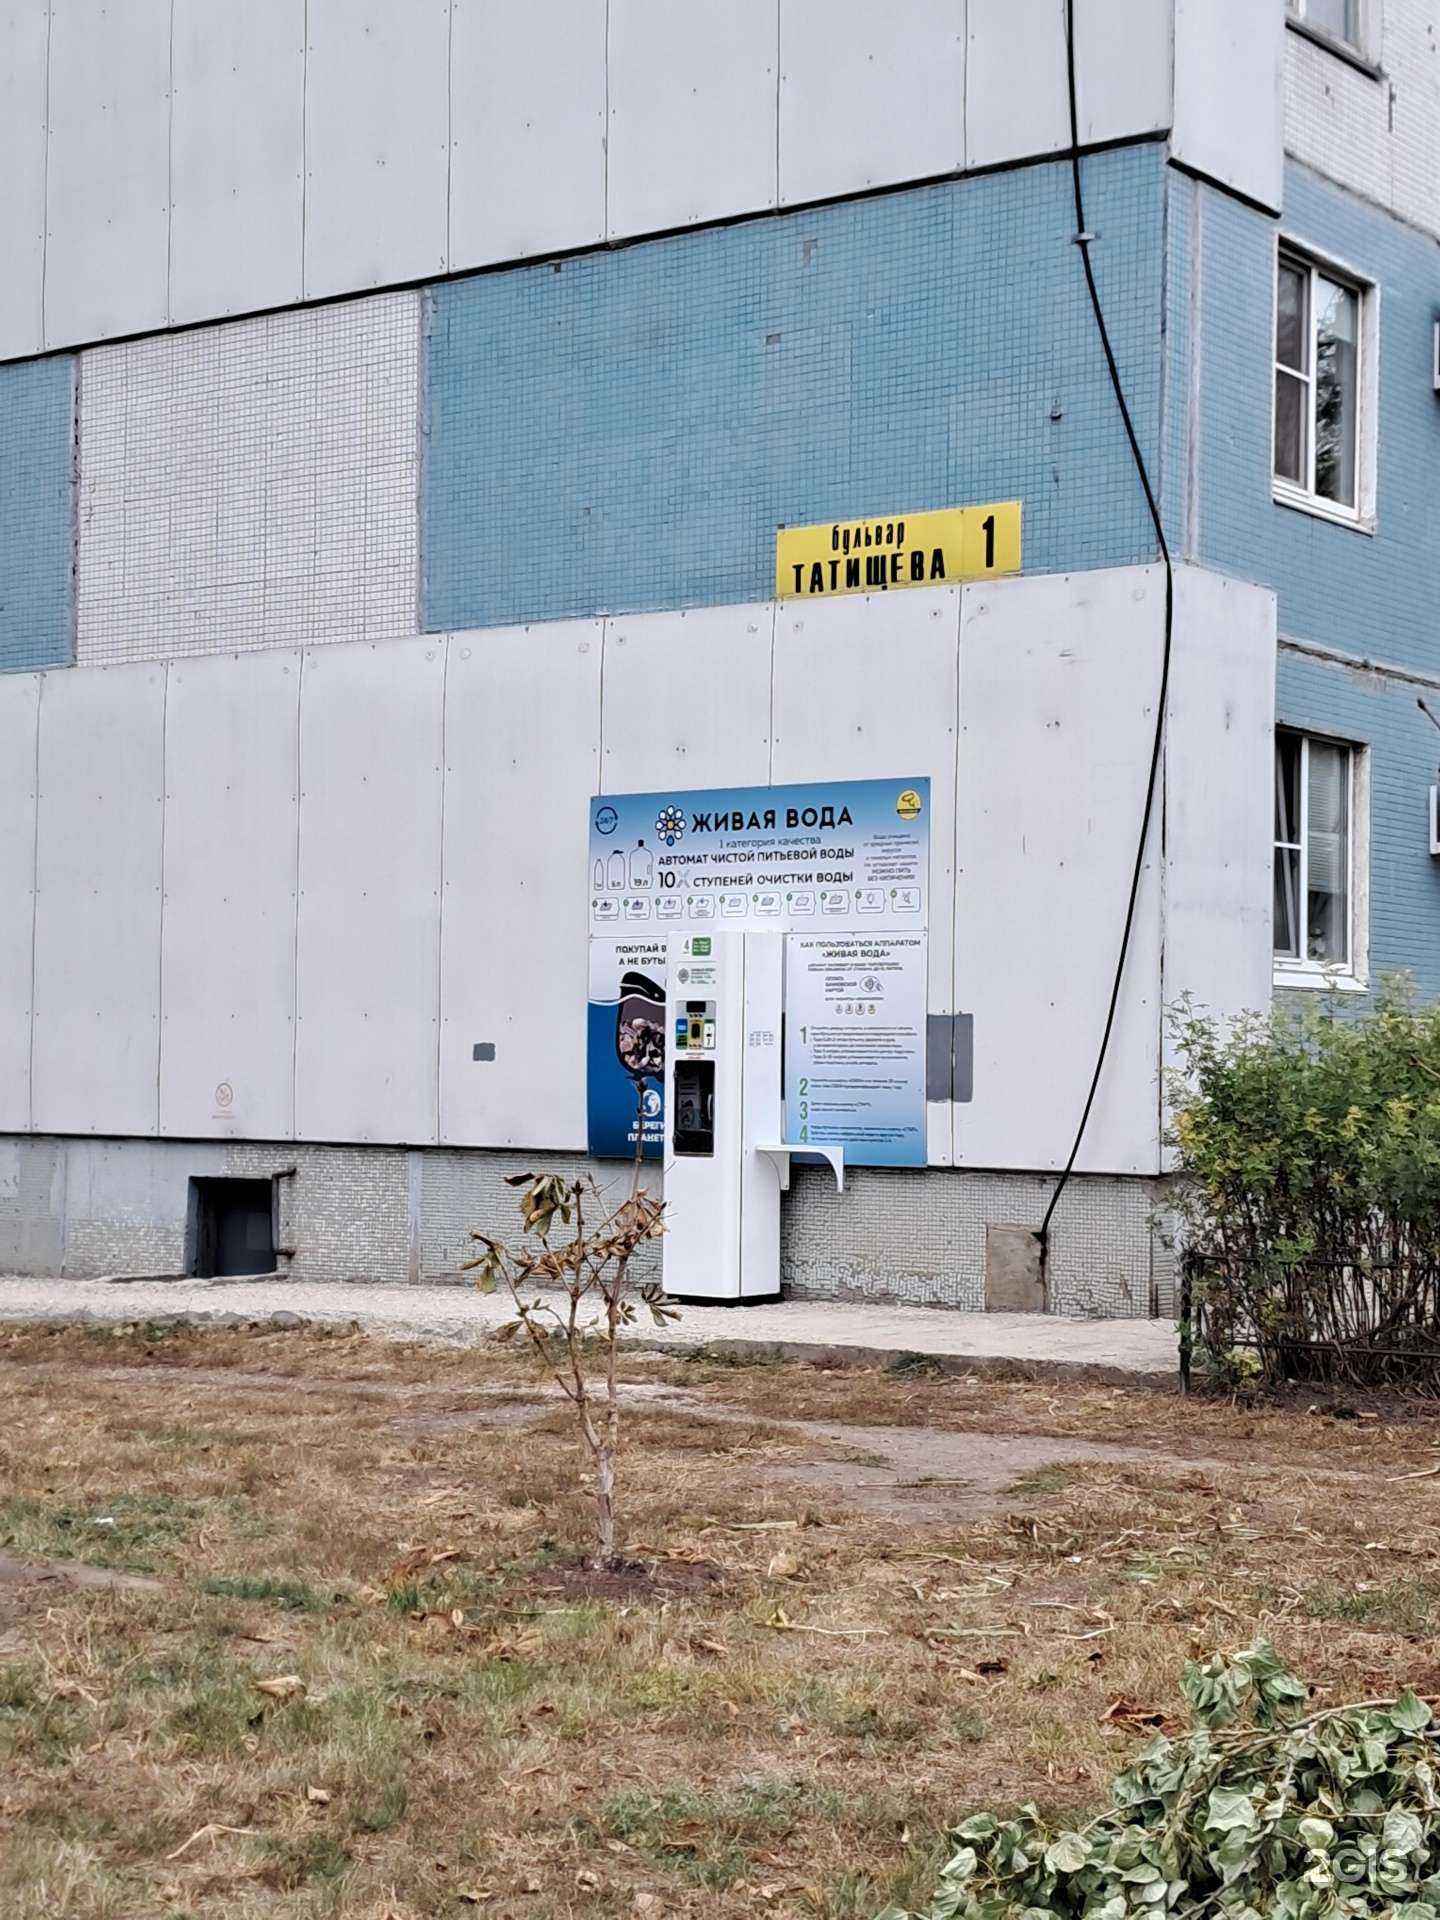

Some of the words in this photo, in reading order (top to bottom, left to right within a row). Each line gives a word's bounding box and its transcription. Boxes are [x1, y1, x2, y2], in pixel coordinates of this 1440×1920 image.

[832, 522, 905, 555] бульвар
[982, 515, 995, 568] 1
[792, 548, 946, 594] ТАТИЩЕВА
[691, 809, 776, 833] ЖИВАЯ
[786, 806, 853, 830] ВОДА
[726, 839, 776, 849] категория
[778, 836, 822, 846] качества
[658, 854, 708, 866] АВТОМАТ
[711, 851, 754, 864] ЧИСТОЙ
[757, 847, 817, 862] ПИТЬЕВОЙ
[820, 848, 855, 859] ВОДЫ
[693, 873, 753, 888] СТУПЕНЕЙ
[757, 873, 812, 885] ОЧИСТКИ
[816, 871, 853, 883] ВОДЫ
[615, 944, 659, 954] ПОКУПАЙ
[815, 940, 873, 948] ПОЛЬЗОВАТЬСЯ
[874, 939, 921, 947] АППАРАТОМ
[627, 957, 639, 965] НЕ
[799, 1078, 809, 1097] 2
[799, 1101, 808, 1120] 3
[799, 1124, 809, 1143] 4
